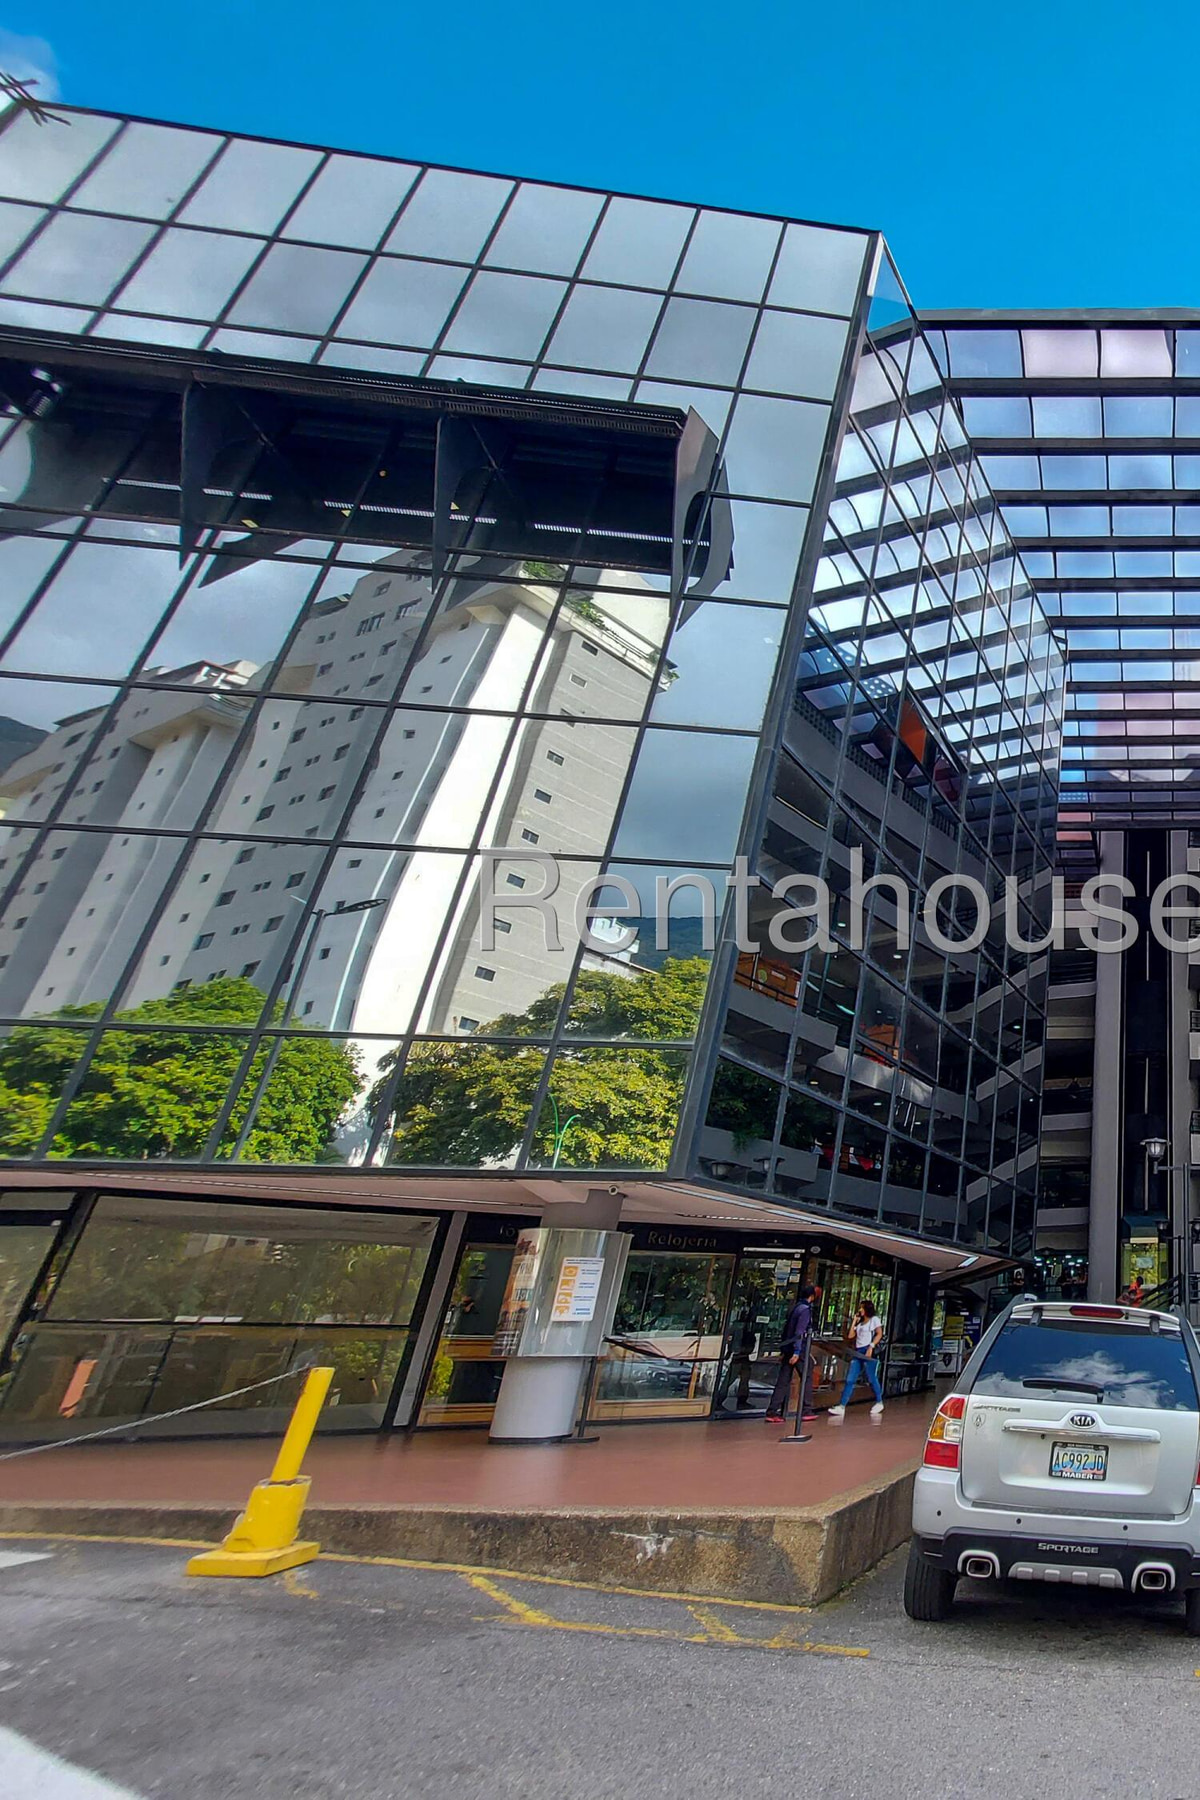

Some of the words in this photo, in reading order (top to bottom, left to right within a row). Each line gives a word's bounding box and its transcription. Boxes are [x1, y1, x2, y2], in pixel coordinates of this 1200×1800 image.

[1073, 1415, 1092, 1425] KIA
[1053, 1452, 1104, 1471] AC992JD
[1037, 1542, 1099, 1554] SPORTAGE
